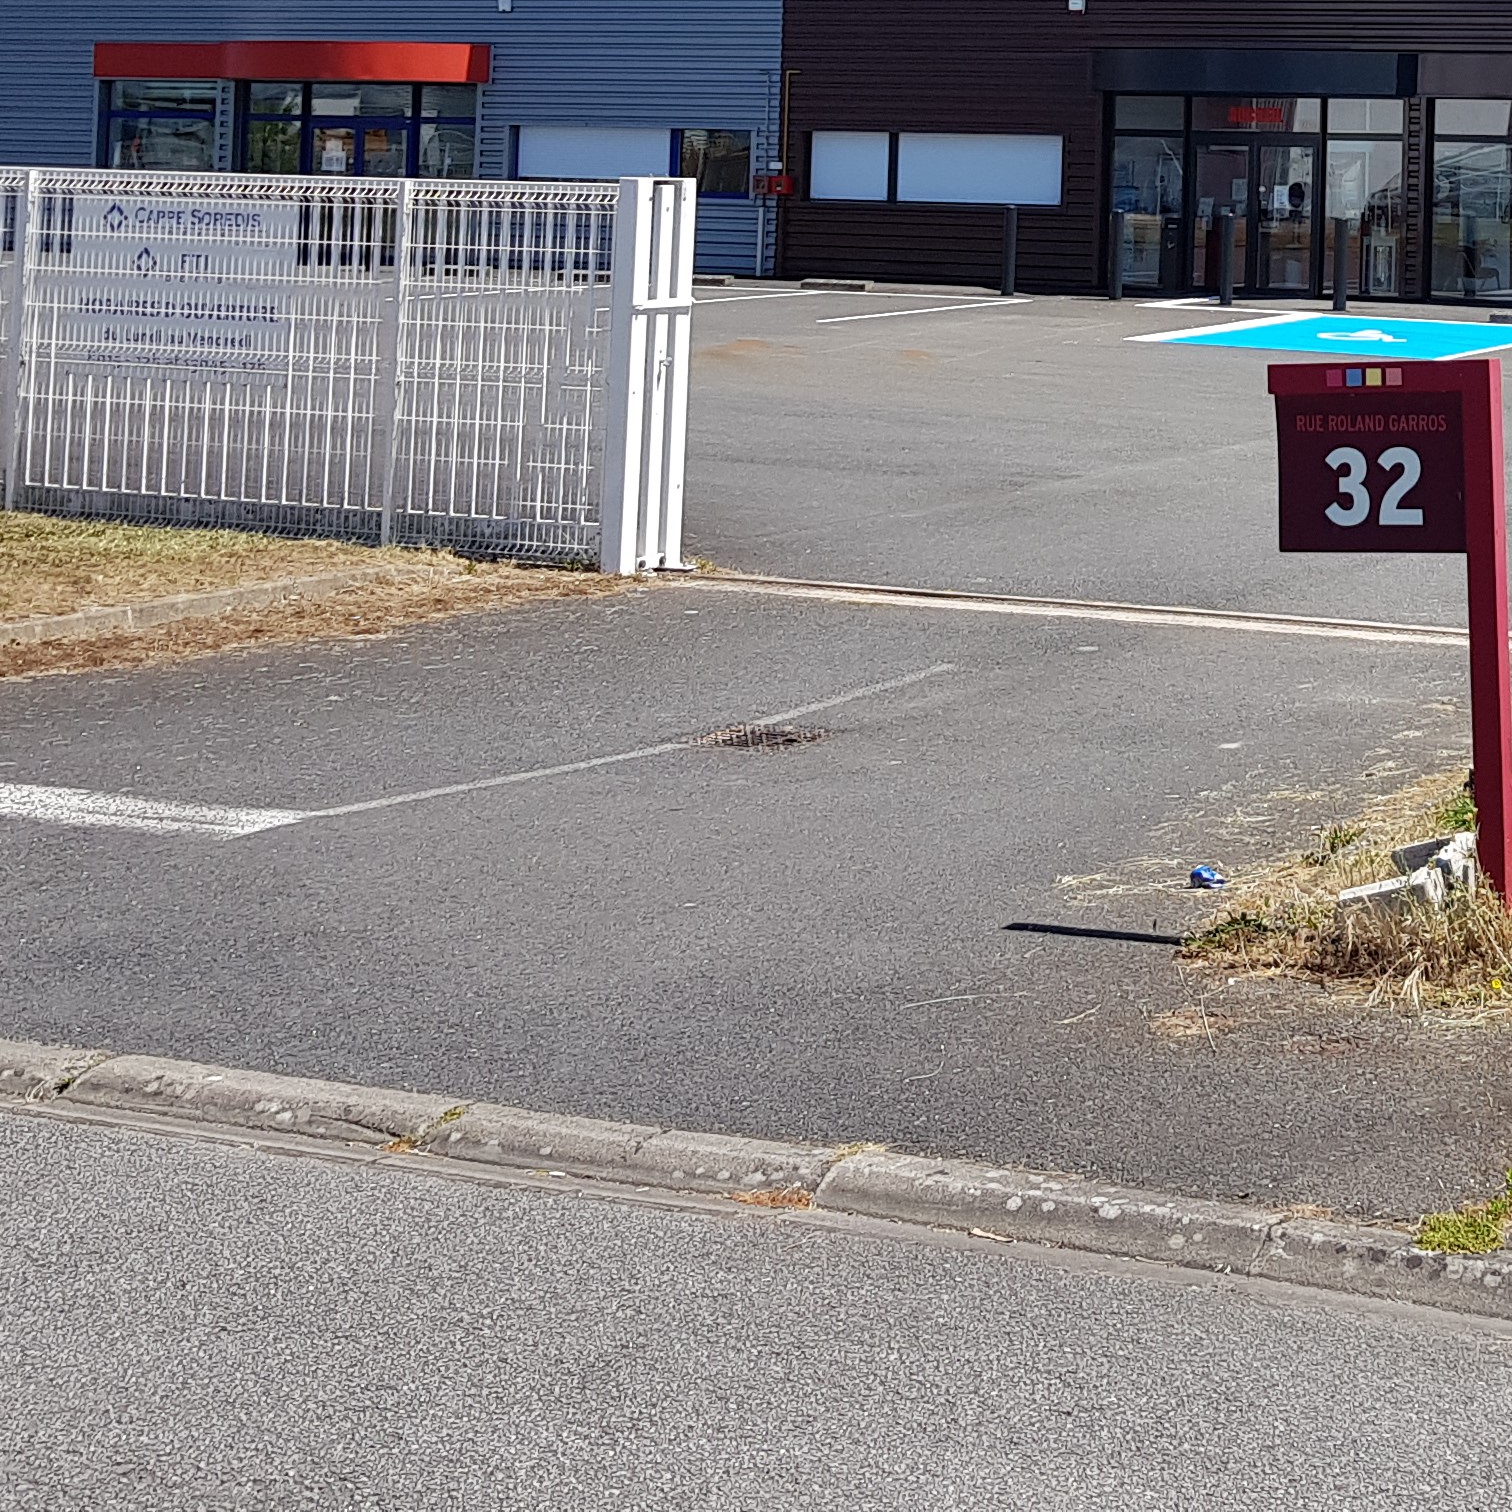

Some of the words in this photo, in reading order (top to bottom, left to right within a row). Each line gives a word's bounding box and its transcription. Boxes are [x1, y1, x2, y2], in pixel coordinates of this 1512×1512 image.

[1296, 414, 1324, 432] RUE
[1328, 414, 1385, 432] ROLAND
[1389, 414, 1447, 432] GARROS
[1325, 446, 1424, 527] 32
